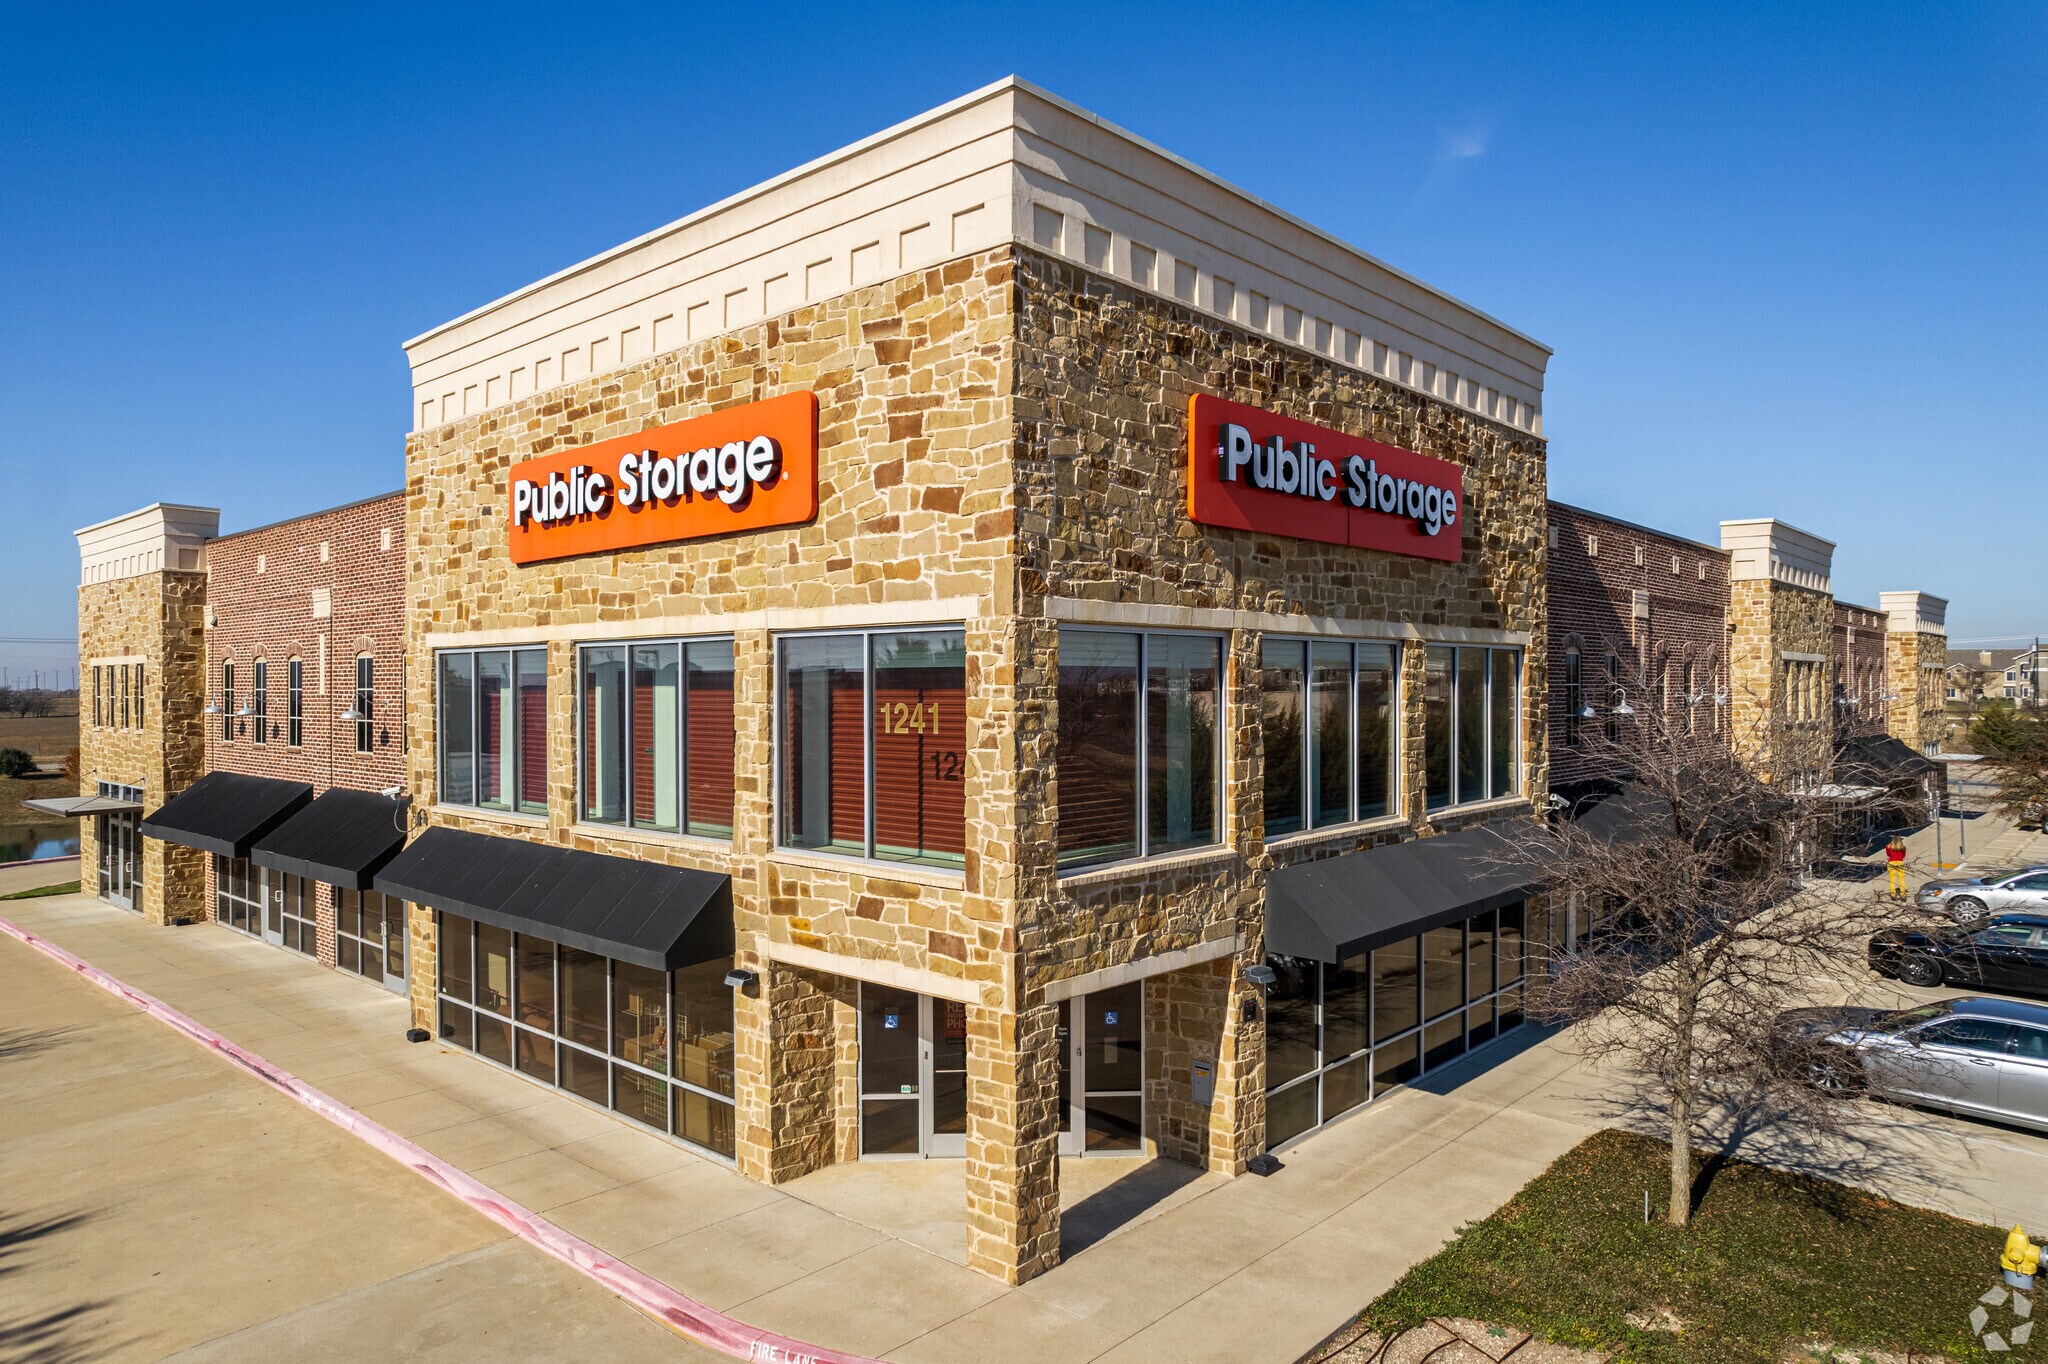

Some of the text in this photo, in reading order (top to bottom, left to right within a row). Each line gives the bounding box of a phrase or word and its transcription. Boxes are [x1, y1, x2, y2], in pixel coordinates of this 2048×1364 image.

[514, 435, 774, 526] Public Storage
[1226, 423, 1457, 536] Public Storage
[881, 702, 939, 734] 1241
[749, 1340, 779, 1362] FIRE
